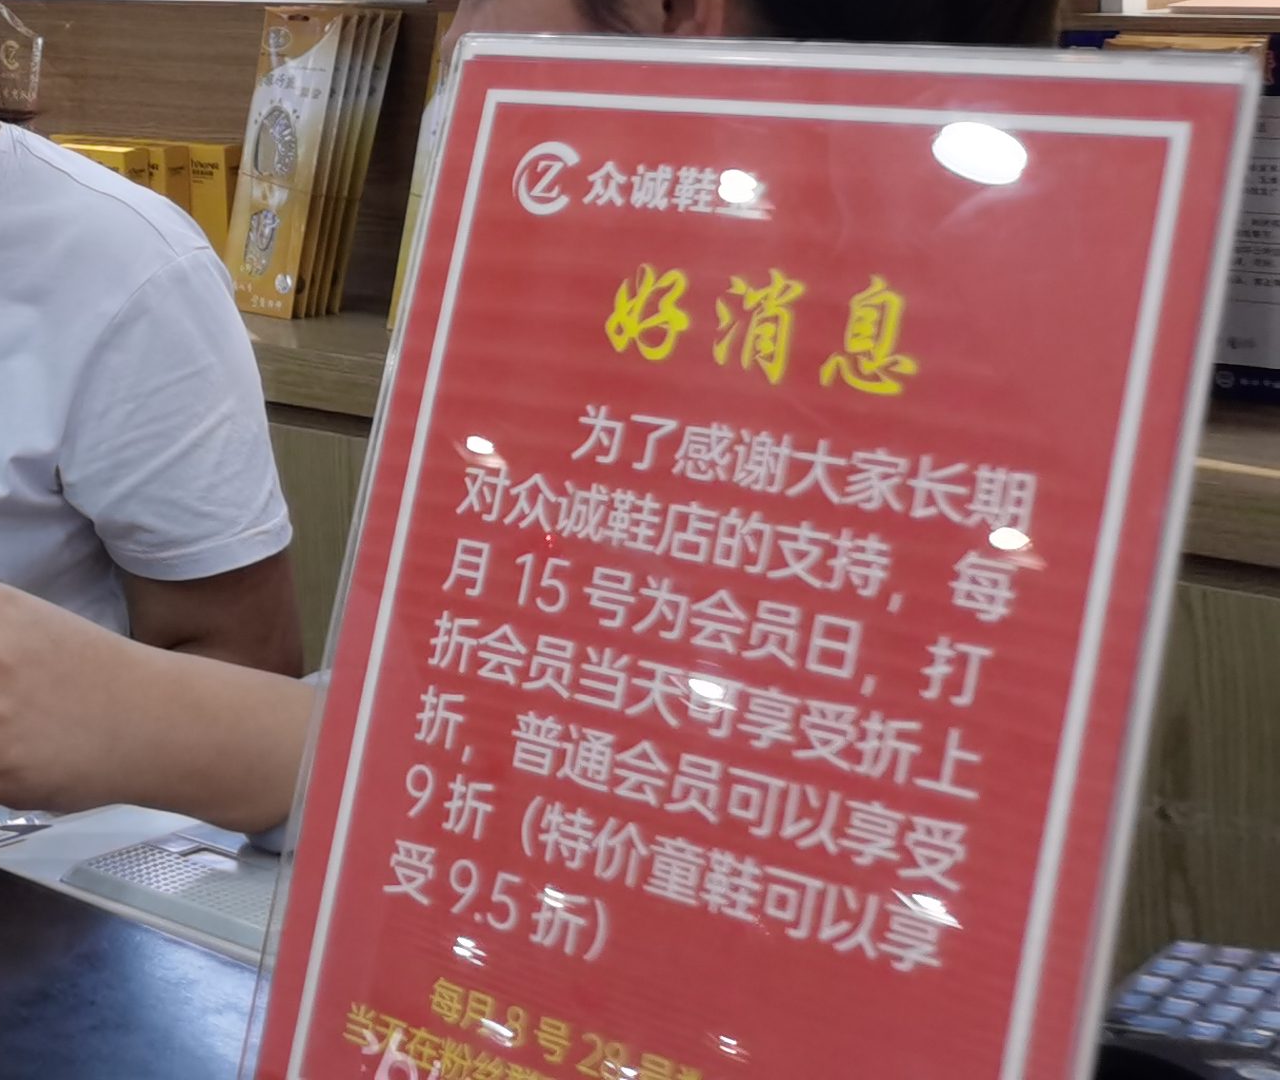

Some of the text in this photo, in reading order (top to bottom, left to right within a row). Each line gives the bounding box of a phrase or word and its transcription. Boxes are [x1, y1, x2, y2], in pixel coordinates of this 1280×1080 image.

[603, 263, 919, 397] 好消息
[570, 403, 1039, 533] 为了感谢大家长期
[427, 615, 982, 801] 折会员当天可享受折上
